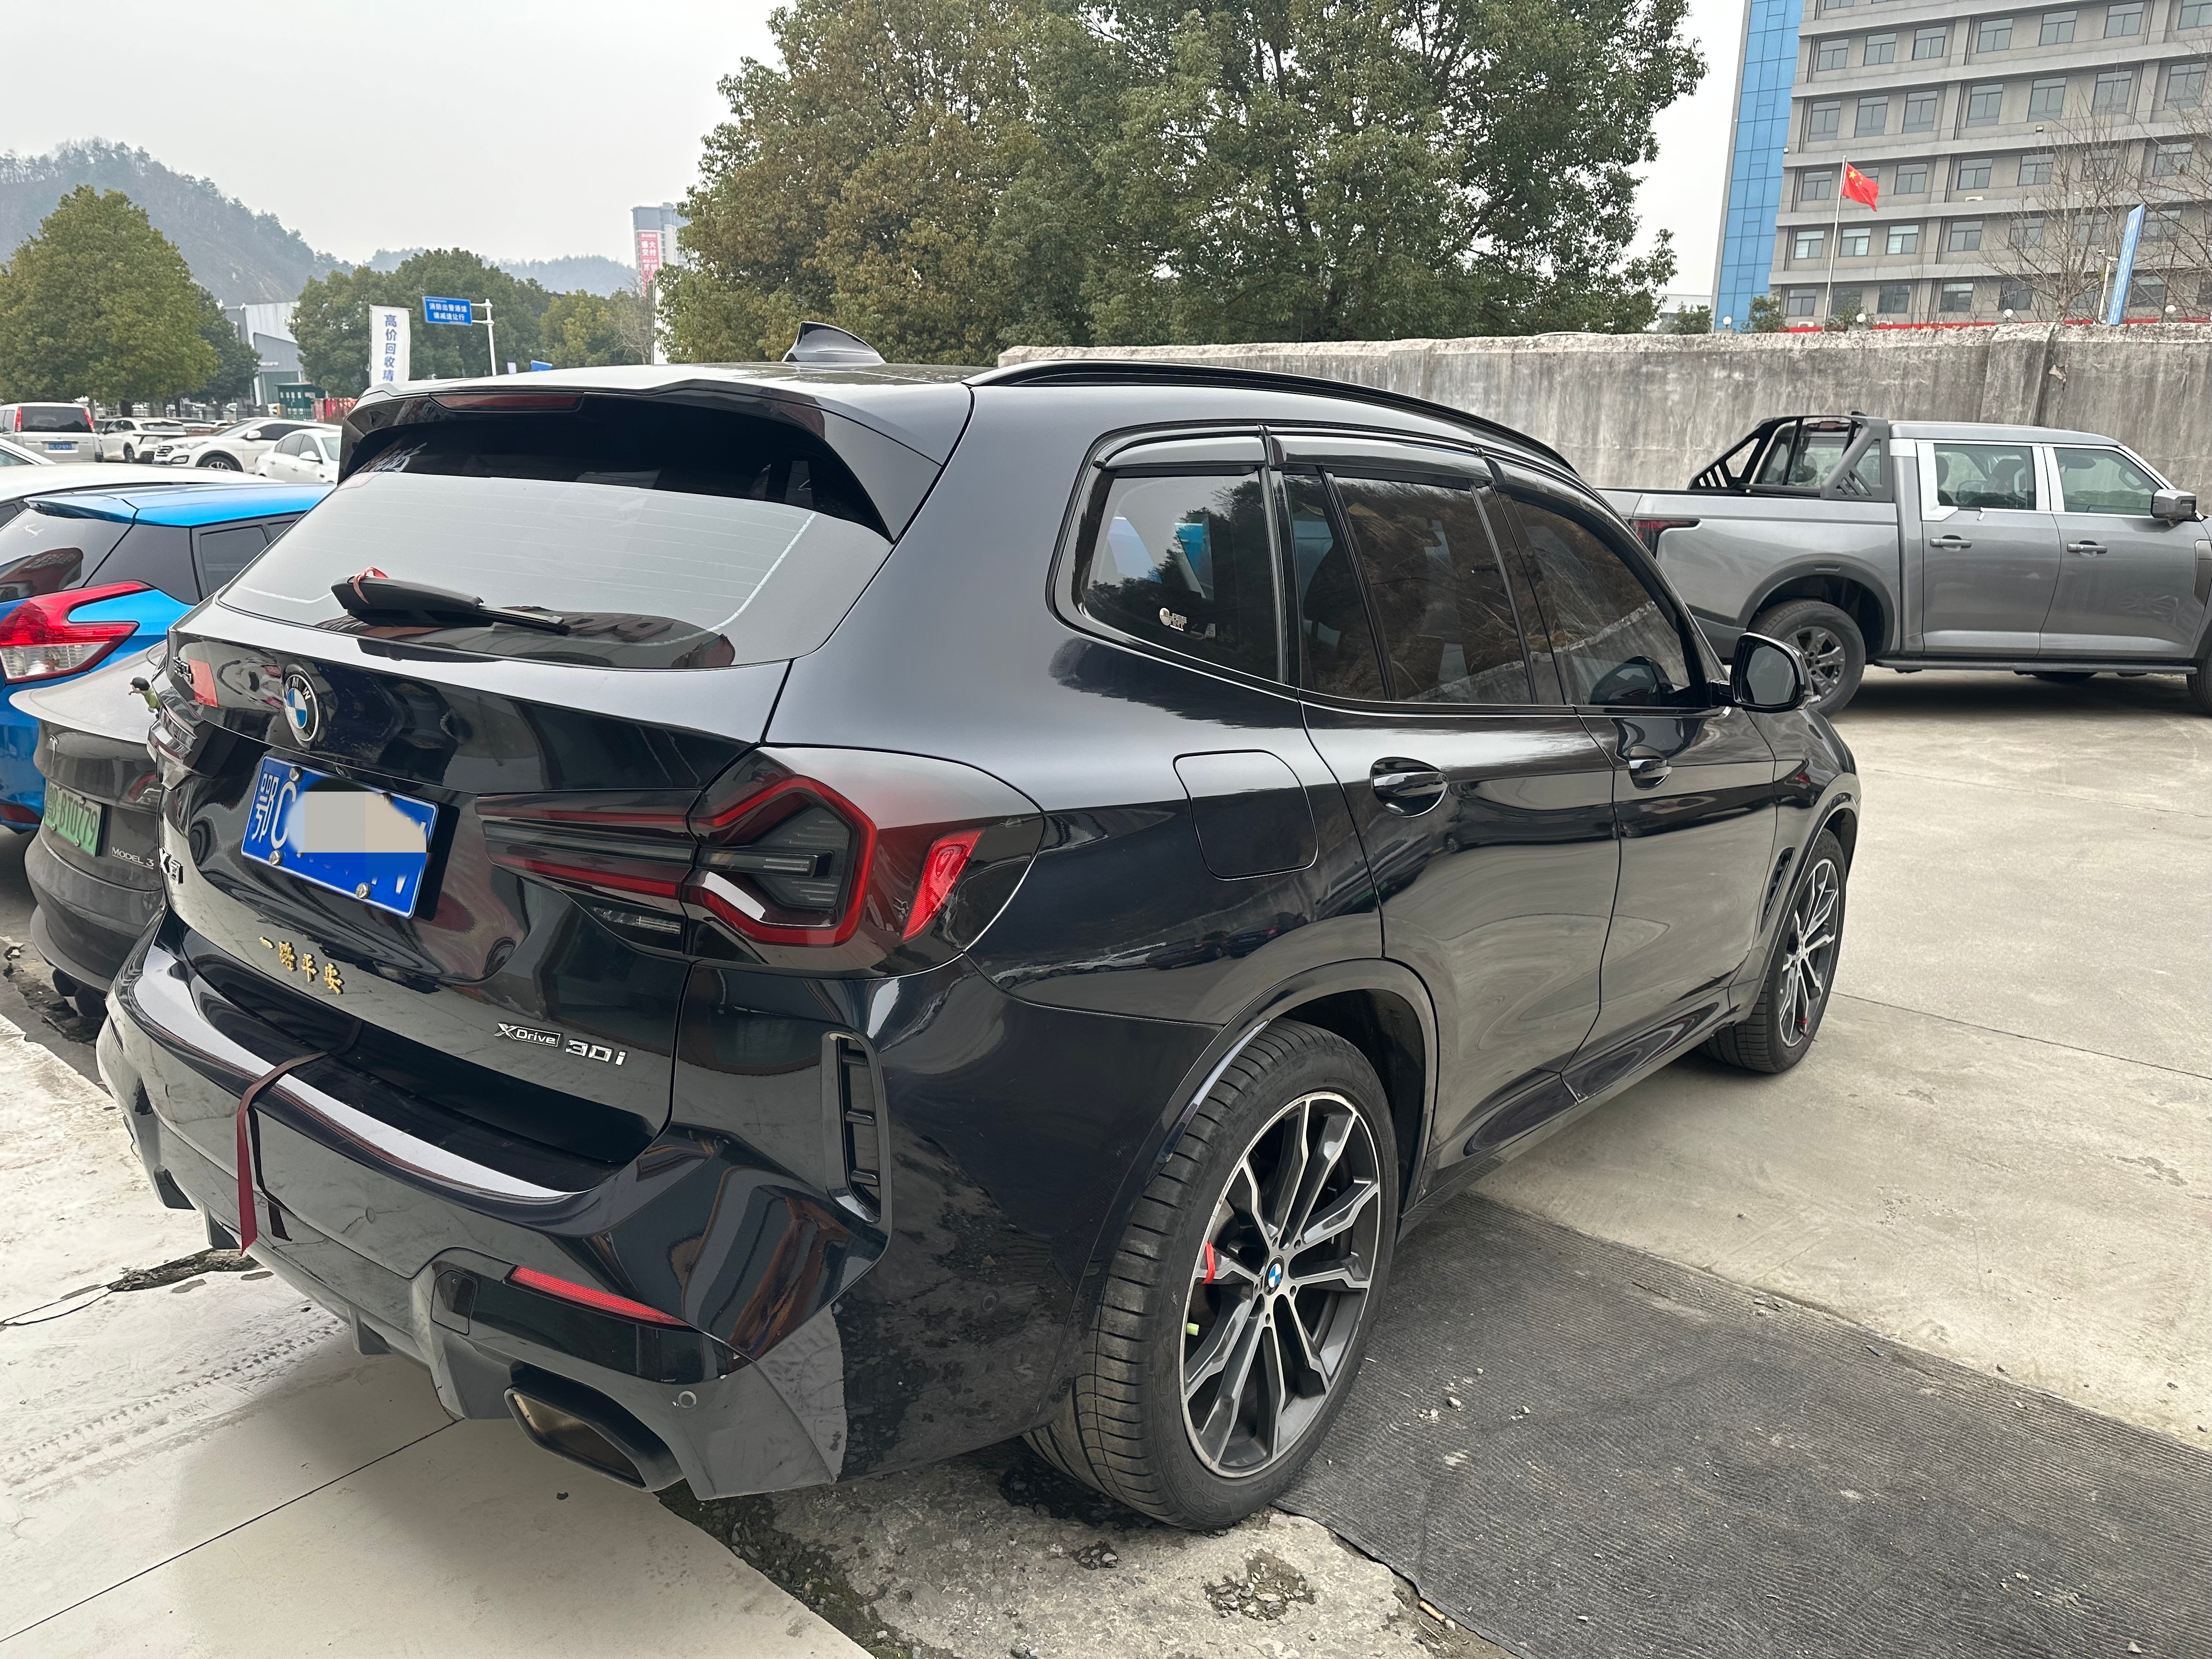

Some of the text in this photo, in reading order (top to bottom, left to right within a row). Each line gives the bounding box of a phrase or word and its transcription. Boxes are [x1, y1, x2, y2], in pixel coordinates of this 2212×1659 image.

[112, 847, 154, 867] MODEL 3
[259, 936, 343, 995] 一路平安
